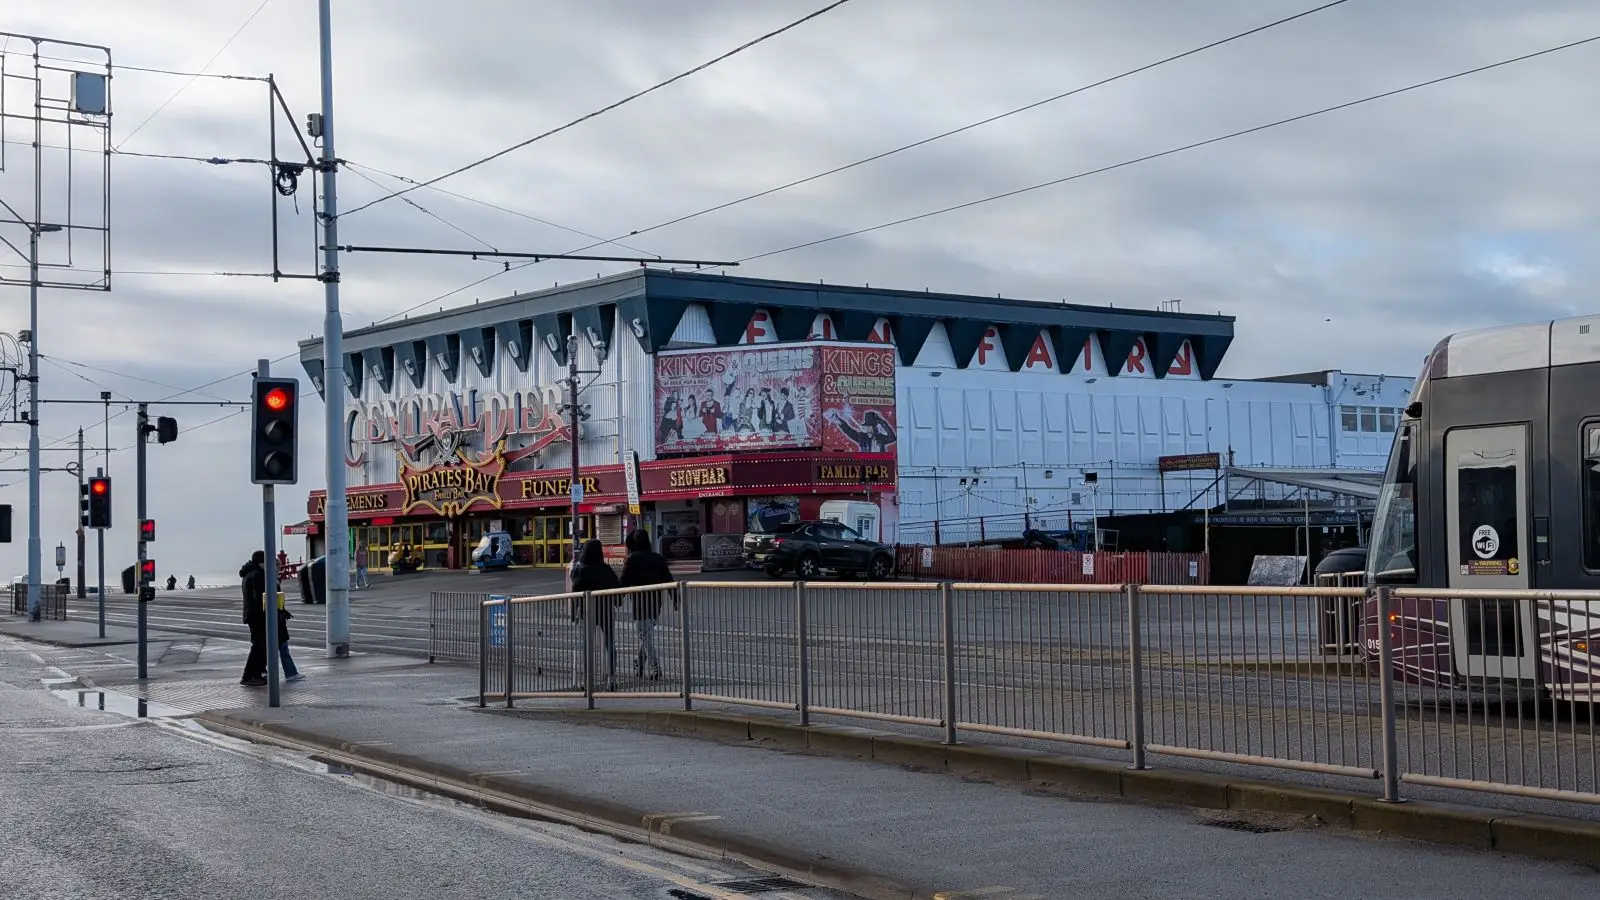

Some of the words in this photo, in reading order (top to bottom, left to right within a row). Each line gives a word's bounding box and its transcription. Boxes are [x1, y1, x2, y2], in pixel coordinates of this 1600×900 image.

[659, 354, 727, 378] KINGS
[731, 359, 739, 369] &
[742, 347, 815, 373] QUEENS
[823, 348, 895, 377] KINGS
[978, 328, 1146, 374] FAIR
[823, 374, 838, 395] &
[837, 374, 895, 397] QUEENS
[344, 387, 485, 467] CENTRAL
[475, 384, 573, 461] PIER
[408, 469, 462, 501] PIRATES
[464, 467, 491, 493] BAY
[670, 467, 726, 487] SHOWBAR
[820, 465, 860, 479] FAMILY
[316, 494, 384, 514] AEMENTS
